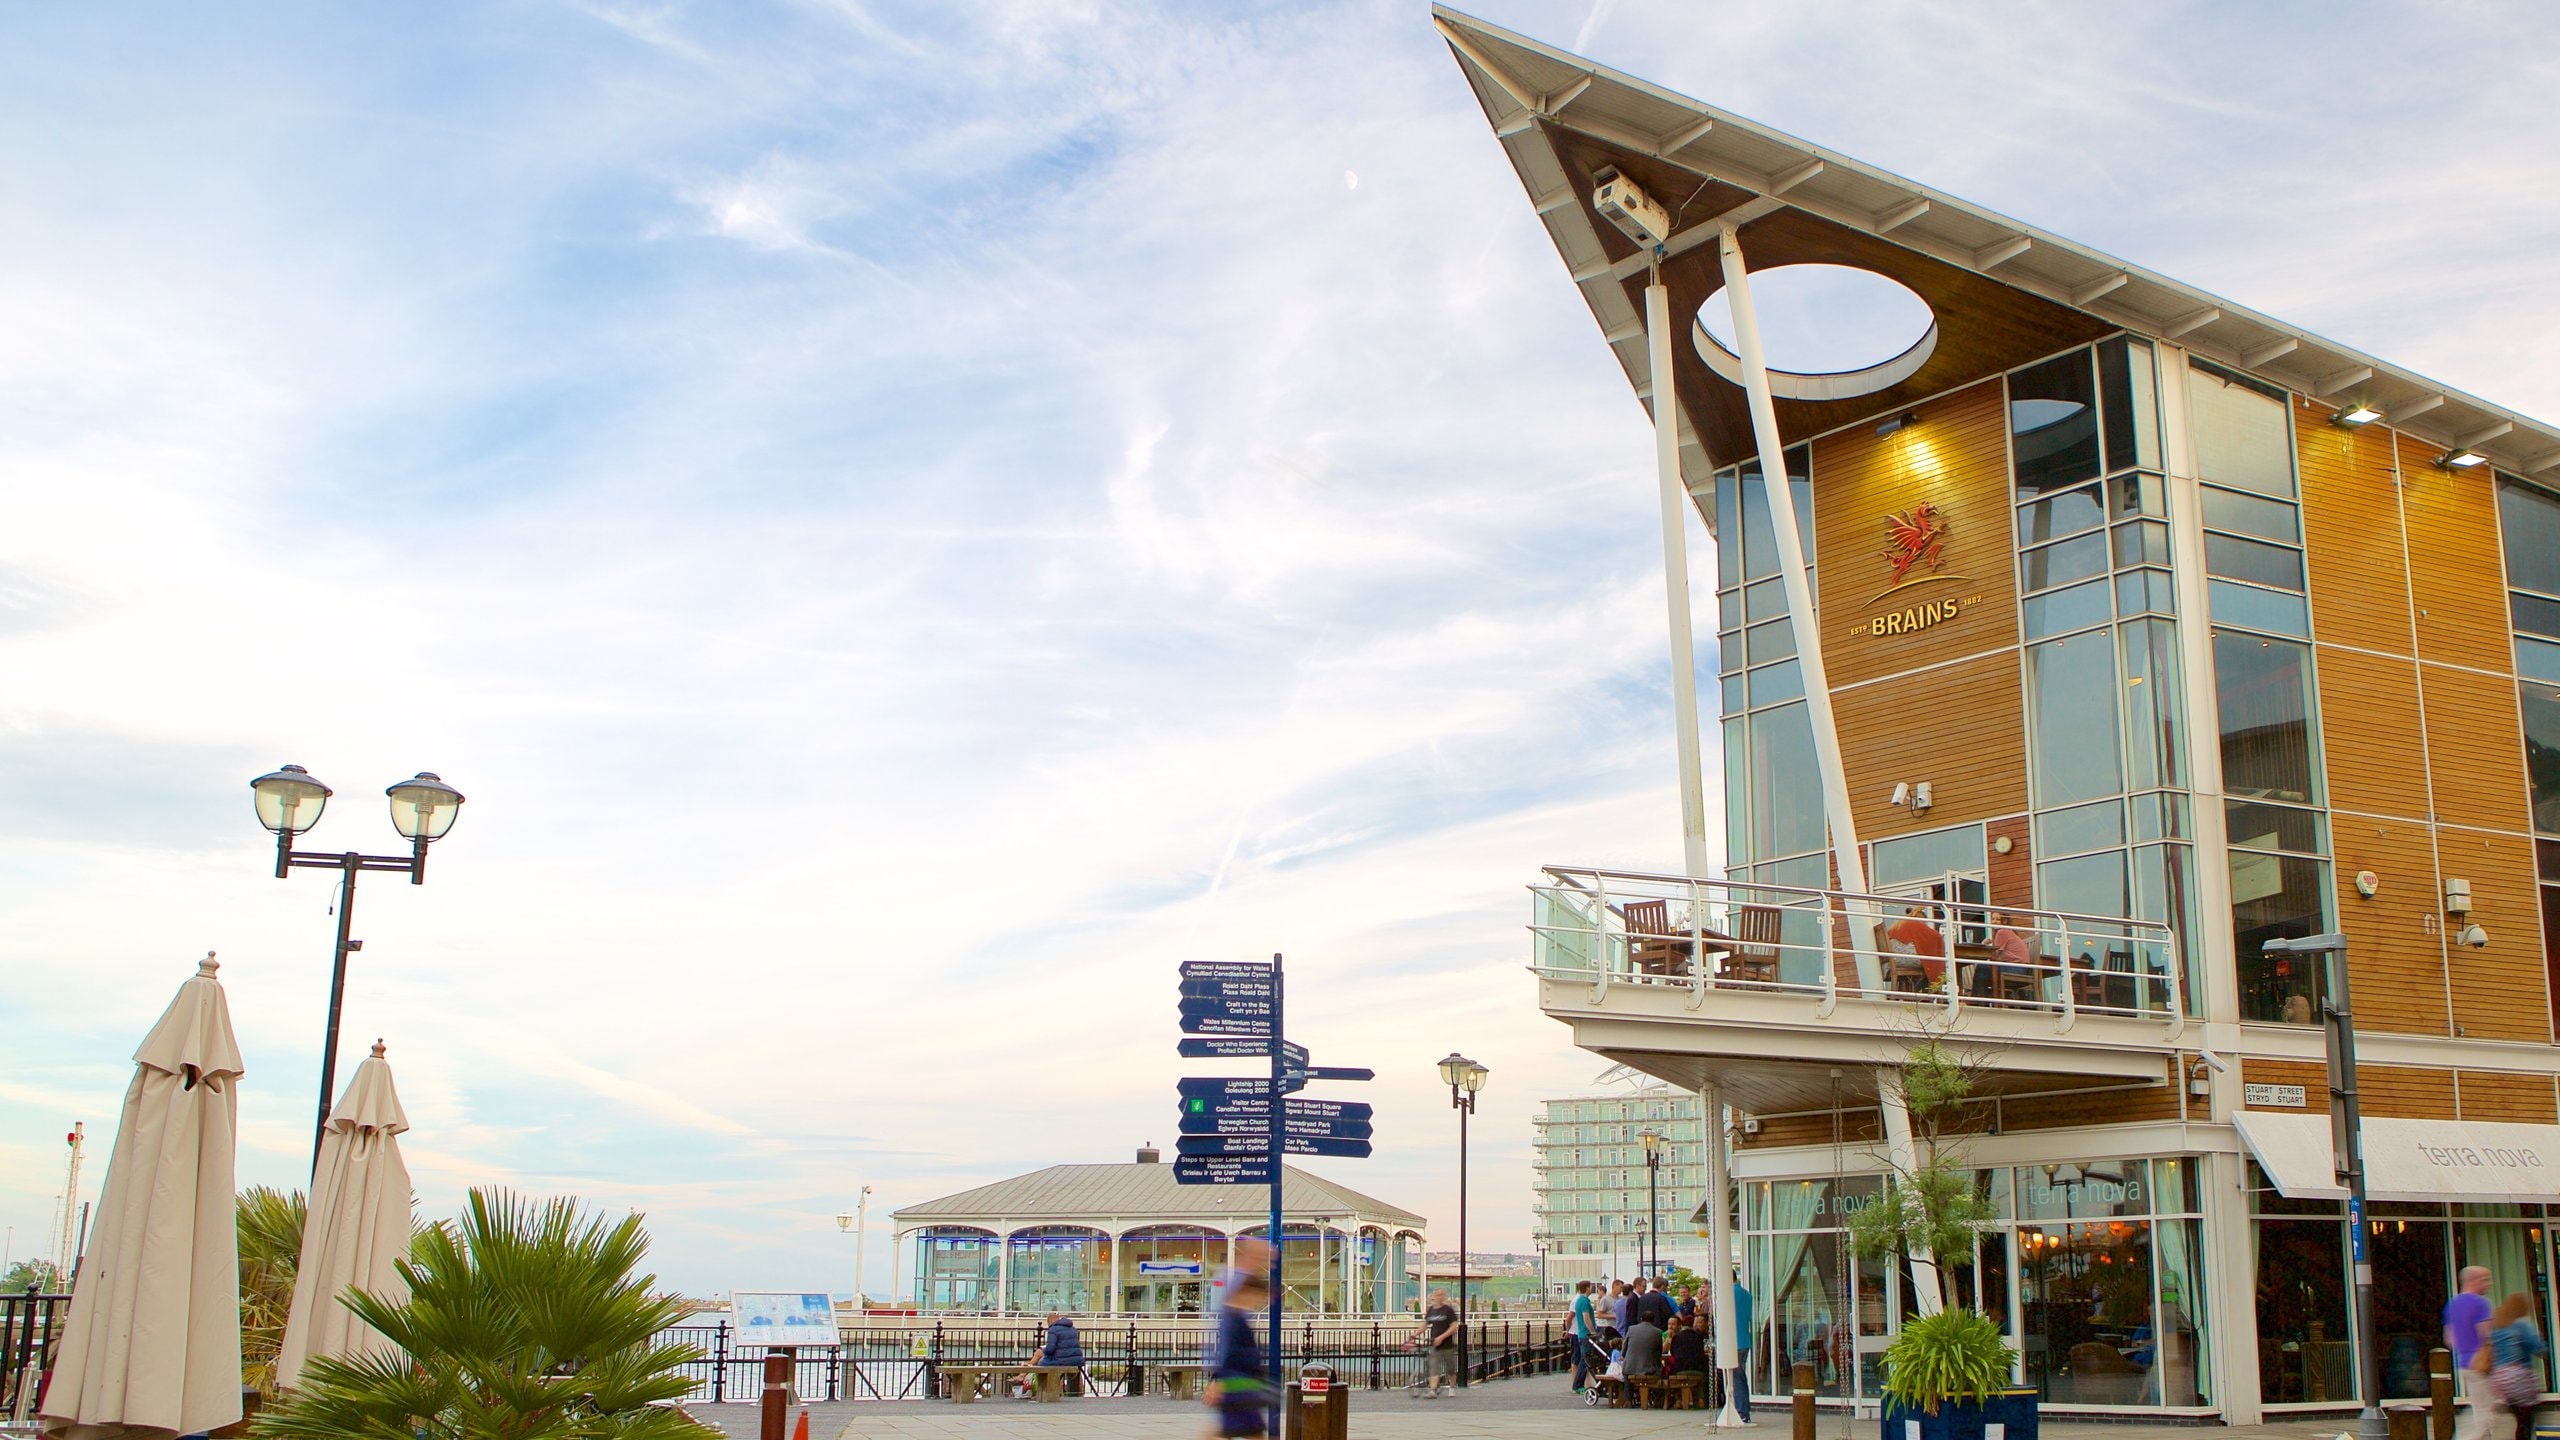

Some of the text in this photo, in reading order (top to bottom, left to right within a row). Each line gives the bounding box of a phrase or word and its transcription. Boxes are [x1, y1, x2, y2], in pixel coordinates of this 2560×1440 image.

[1872, 598, 1958, 635] BRAINS
[1964, 595, 1982, 606] 1882
[2246, 1086, 2303, 1095] STUART STREET
[2248, 1094, 2303, 1104] STRYD STUART
[1285, 1120, 1316, 1128] Hamadryad
[1299, 1127, 1330, 1135] Hamadryad
[2418, 1142, 2545, 1168] terra nova
[2030, 1179, 2140, 1205] terra nova
